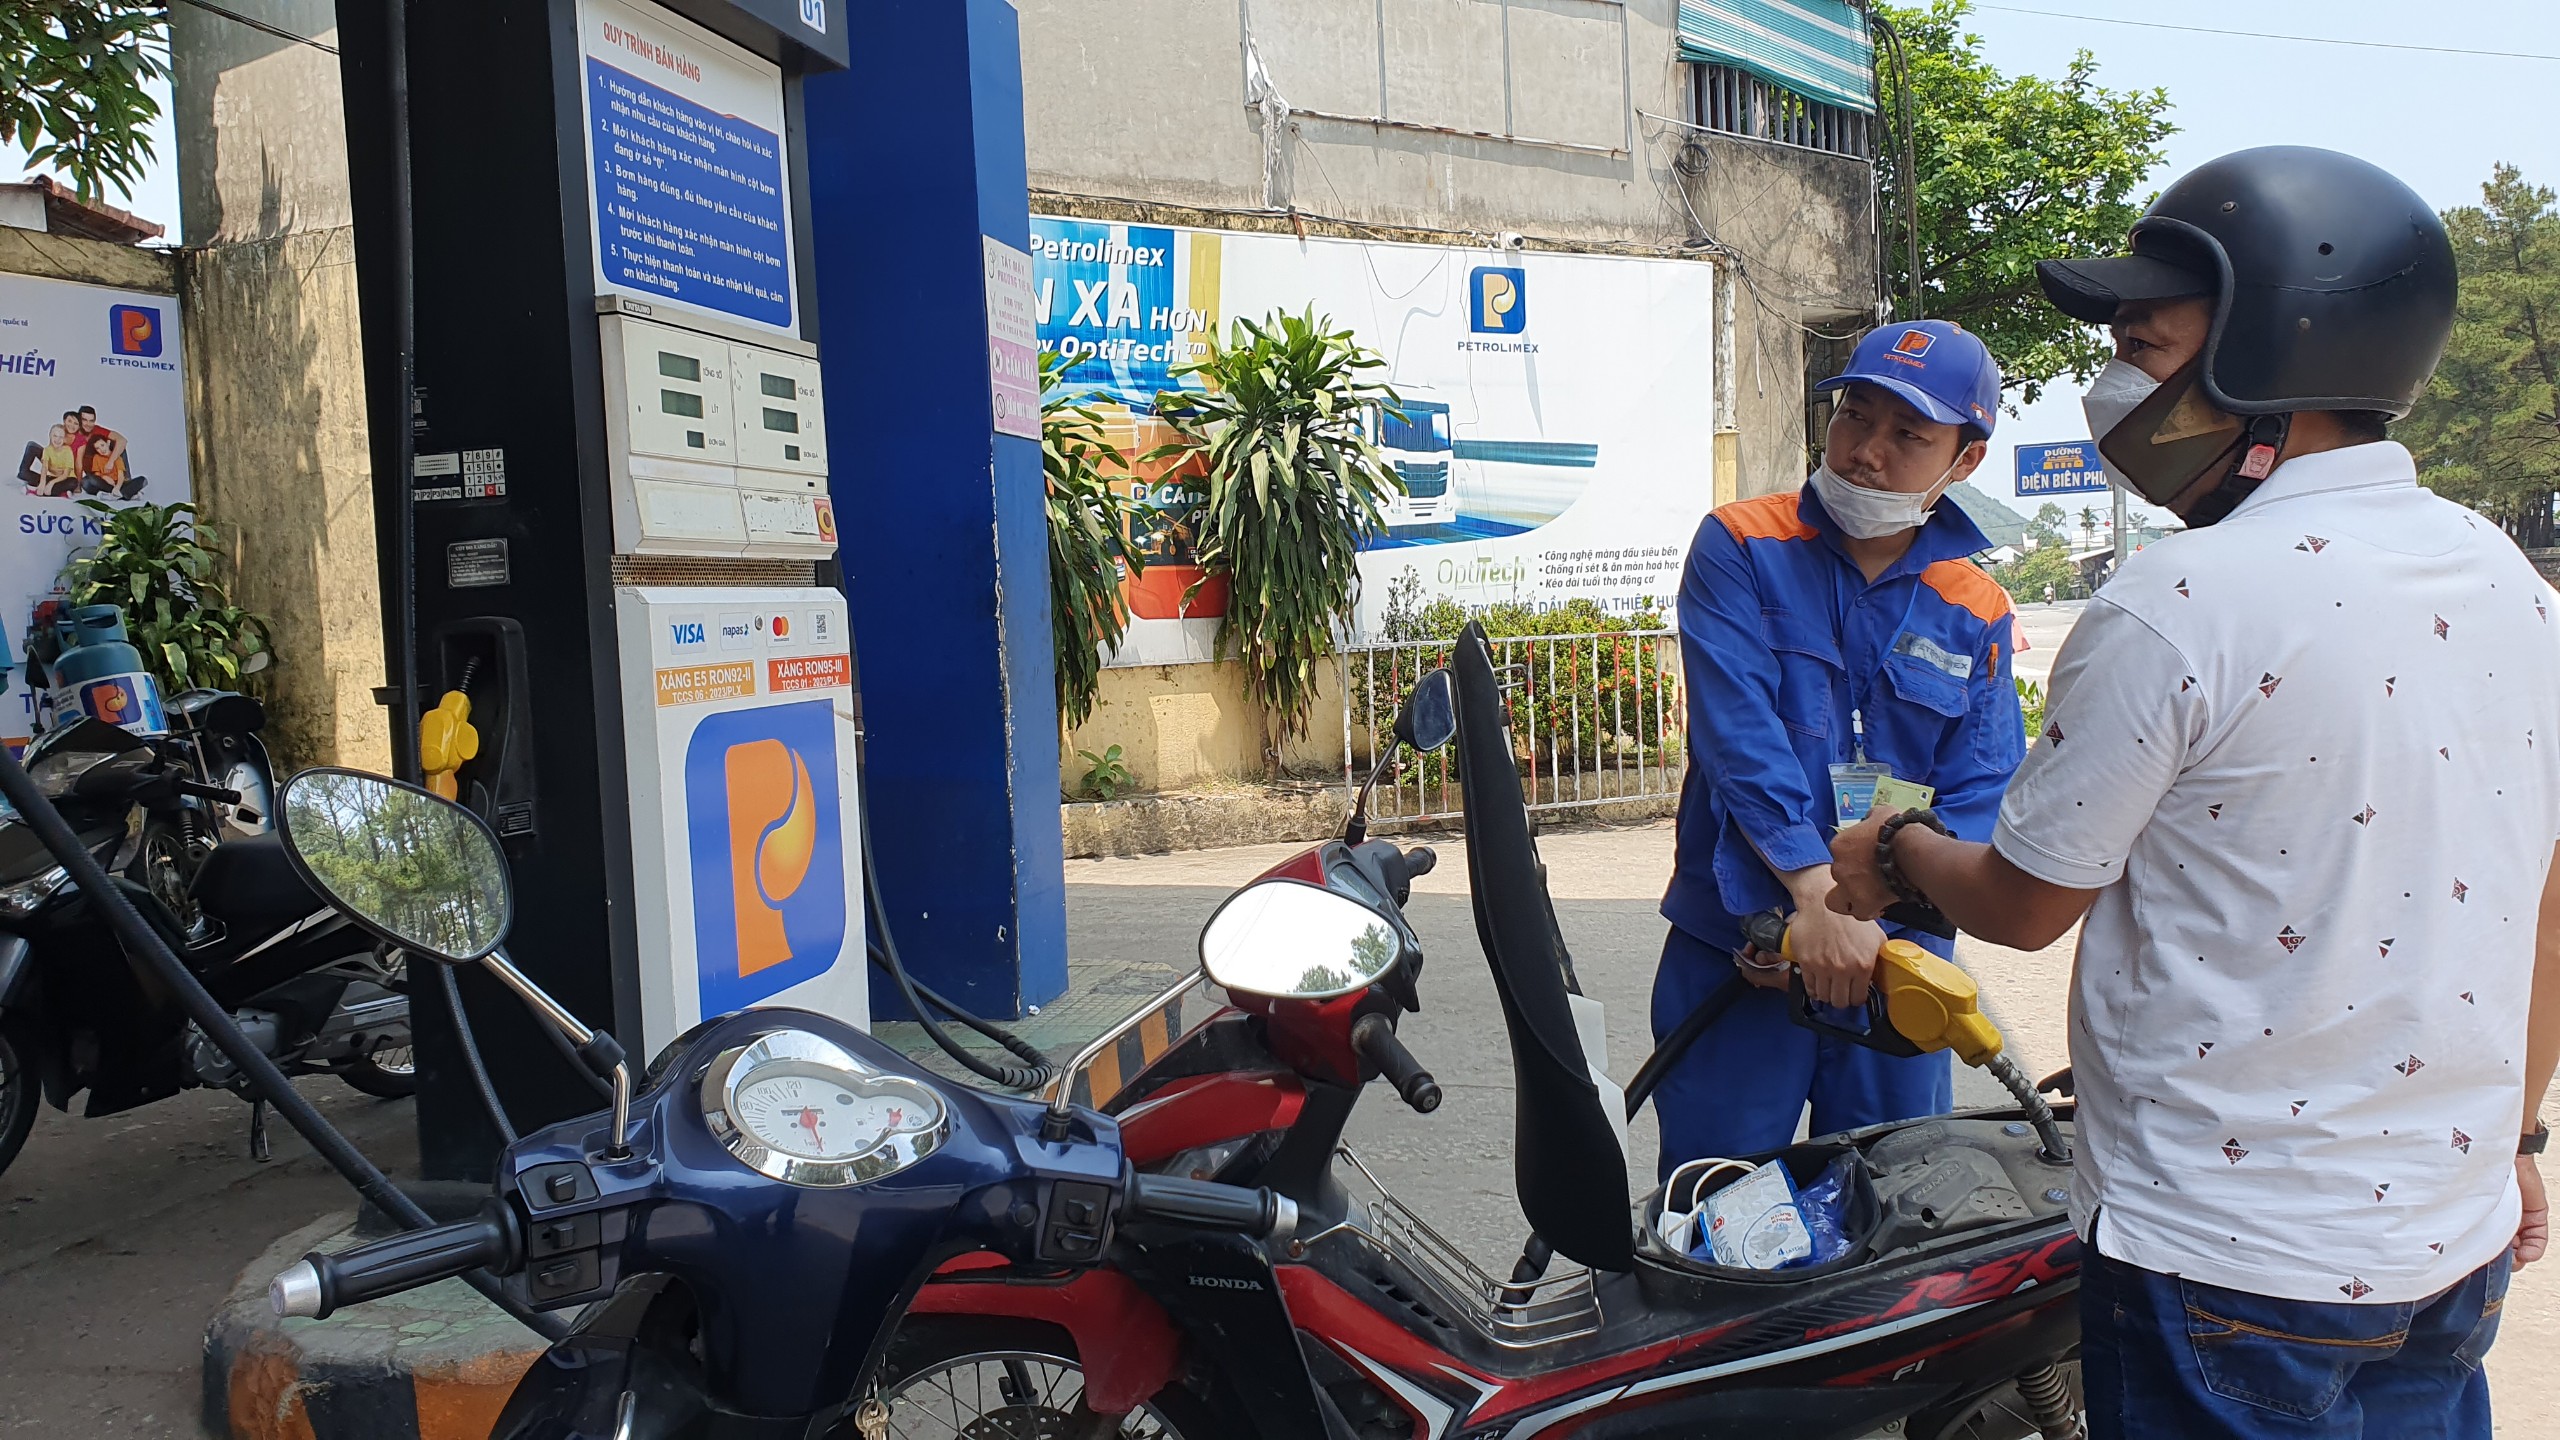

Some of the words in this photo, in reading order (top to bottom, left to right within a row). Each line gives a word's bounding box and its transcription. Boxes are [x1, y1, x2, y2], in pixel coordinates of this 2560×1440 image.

[604, 21, 623, 47] QUY
[624, 32, 654, 61] TRÌNH
[655, 44, 675, 72] BÁN
[676, 54, 701, 83] HÀNG
[598, 75, 606, 88] 1.
[609, 79, 636, 104] Hướng
[653, 98, 674, 118] khách
[676, 108, 693, 128] hàng
[694, 117, 706, 130] vào
[753, 143, 760, 154] và
[762, 147, 772, 159] xác
[611, 100, 630, 117] nhận
[632, 109, 646, 123] nhu
[662, 121, 675, 135] của
[676, 125, 697, 144] khách
[698, 134, 716, 154] hàng.
[602, 118, 609, 132] 2.
[613, 122, 629, 140] Mời
[630, 130, 655, 150] khách
[657, 140, 677, 161] hàng
[679, 150, 692, 164] xác
[694, 156, 713, 173] nhận
[714, 164, 729, 179] màn
[760, 181, 776, 196] bơm
[614, 142, 633, 162] đang
[604, 160, 612, 174] 3.
[616, 164, 636, 182] Bơm
[638, 171, 658, 192] hàng
[696, 194, 713, 209] theo
[757, 215, 778, 232] khách
[617, 182, 638, 202] hàng.
[608, 202, 615, 216] 4.
[619, 205, 635, 222] Mời
[636, 211, 662, 230] khách
[663, 220, 683, 240] hàng
[684, 228, 698, 242] xác
[700, 233, 718, 249] nhận
[719, 240, 735, 254] màn
[736, 243, 752, 259] hình
[753, 250, 765, 264] cột
[765, 255, 780, 268] bơm
[620, 224, 642, 241] trước
[643, 230, 655, 245] khi
[656, 235, 677, 252] thanh
[678, 242, 696, 257] toán.
[1030, 234, 1165, 268] Petrolimex
[611, 243, 619, 257] 5.
[622, 246, 643, 265] Thực
[644, 253, 662, 270] hiện
[662, 259, 684, 275] thanh
[685, 265, 701, 280] toán
[703, 271, 711, 282] và
[712, 274, 725, 287] xác
[726, 278, 743, 294] nhận
[744, 281, 754, 295] kết
[770, 290, 784, 303] cảm
[624, 267, 634, 278] ơn
[635, 268, 658, 285] khách
[660, 275, 679, 293] hàng.
[1068, 279, 1142, 330] XA
[1150, 304, 1207, 333] HƠN
[1060, 336, 1180, 365] OptiTech
[1457, 341, 1539, 354] PETROLIMEX
[101, 357, 176, 372] PETROLIMEX
[465, 452, 470, 460] 7
[485, 451, 491, 459] 9
[466, 464, 471, 472] 4
[467, 476, 471, 484] 1
[477, 476, 482, 484] 2
[487, 475, 492, 483] 3
[2052, 469, 2080, 488] BIÊN
[421, 490, 430, 498] P2
[432, 489, 440, 497] P3
[442, 488, 451, 496] P4
[468, 488, 473, 496] 0
[19, 510, 74, 535] SỨC
[1545, 550, 1568, 562] Công
[1570, 549, 1593, 561] nghệ
[1641, 547, 1660, 557] siêu
[1545, 563, 1574, 576] Chống
[1585, 562, 1600, 573] sét
[1602, 563, 1609, 572] &
[1646, 560, 1662, 570] hoá
[1664, 560, 1680, 571] học
[1545, 577, 1563, 588] Kéo
[1565, 577, 1580, 587] dài
[1603, 576, 1618, 587] thọ
[1620, 575, 1642, 586] động
[1644, 574, 1656, 584] cơ
[670, 623, 705, 645] VISA
[722, 624, 744, 639] napas
[777, 660, 803, 678] XĂNG
[805, 658, 842, 676] RON95-III
[660, 670, 691, 690] XĂNG
[694, 670, 707, 687] E5
[709, 666, 751, 685] RON92-II
[782, 679, 800, 691] TCCS
[801, 678, 808, 688] 01
[812, 675, 840, 688] 2023/PLX
[672, 690, 694, 703] TCCS
[695, 689, 704, 700] 06
[709, 685, 742, 699] 2023/PLX
[757, 1086, 772, 1095] 100
[785, 1080, 802, 1089] 120
[740, 1101, 754, 1110] 80
[1777, 1247, 1784, 1256] 4
[1188, 1275, 1264, 1290] HONDA
